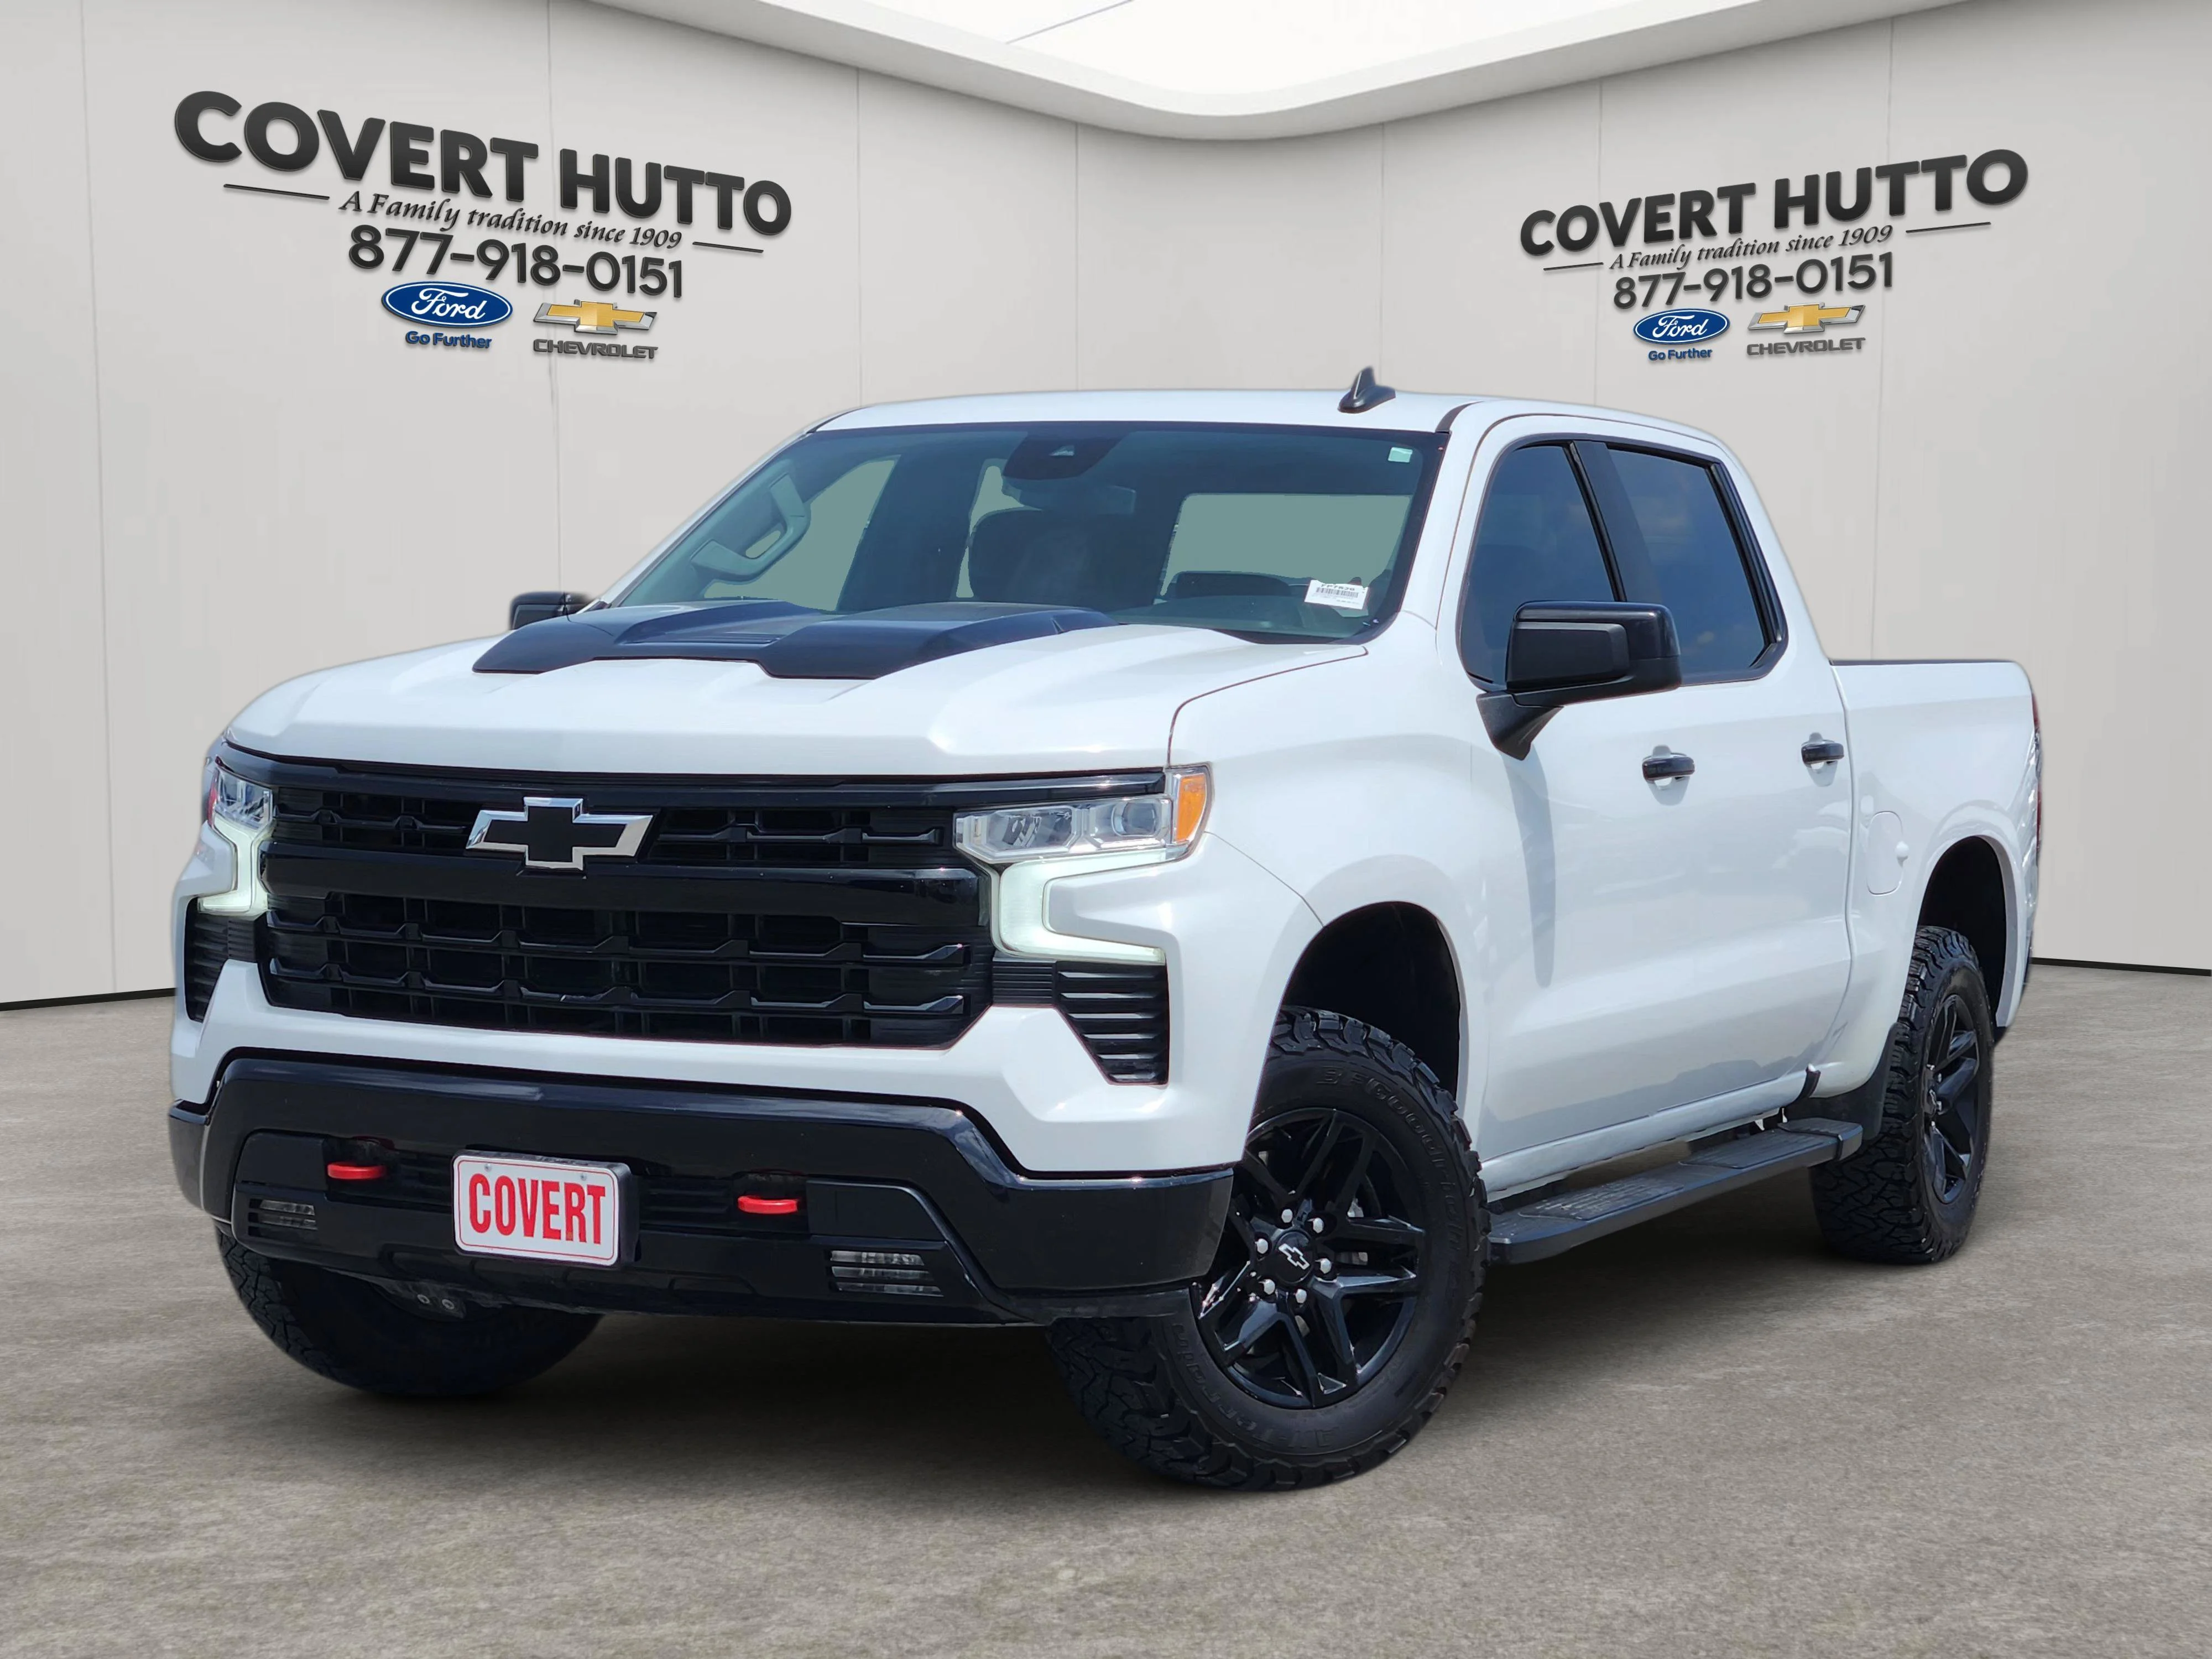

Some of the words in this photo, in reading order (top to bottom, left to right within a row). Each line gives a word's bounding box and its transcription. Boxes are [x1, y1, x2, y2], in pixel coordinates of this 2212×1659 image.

[174, 91, 539, 203] COVERT
[560, 148, 791, 237] HUTTO
[338, 191, 362, 212] A
[367, 193, 461, 232] Family
[467, 207, 568, 236] tradition
[573, 221, 625, 243] since
[629, 227, 682, 249] 1909
[1520, 182, 1756, 257] COVERT
[1774, 149, 2028, 230] HUTTO
[348, 225, 682, 299] 877-918-0151
[1609, 253, 1624, 270] A
[1627, 243, 1692, 270] Family
[1697, 237, 1780, 261] tradition
[1785, 234, 1834, 252] since
[1838, 225, 1893, 247] 1909
[1614, 251, 1892, 310] 877-918-0151
[411, 287, 488, 321] Ford
[1652, 314, 1709, 338] Ford
[405, 331, 431, 346] Go
[432, 332, 492, 349] Further
[533, 338, 659, 359] CHEVROLET
[1648, 351, 1666, 361] Go
[1667, 347, 1713, 360] Further
[1746, 337, 1866, 356] CHEVROLET
[468, 1173, 606, 1245] COVERT
